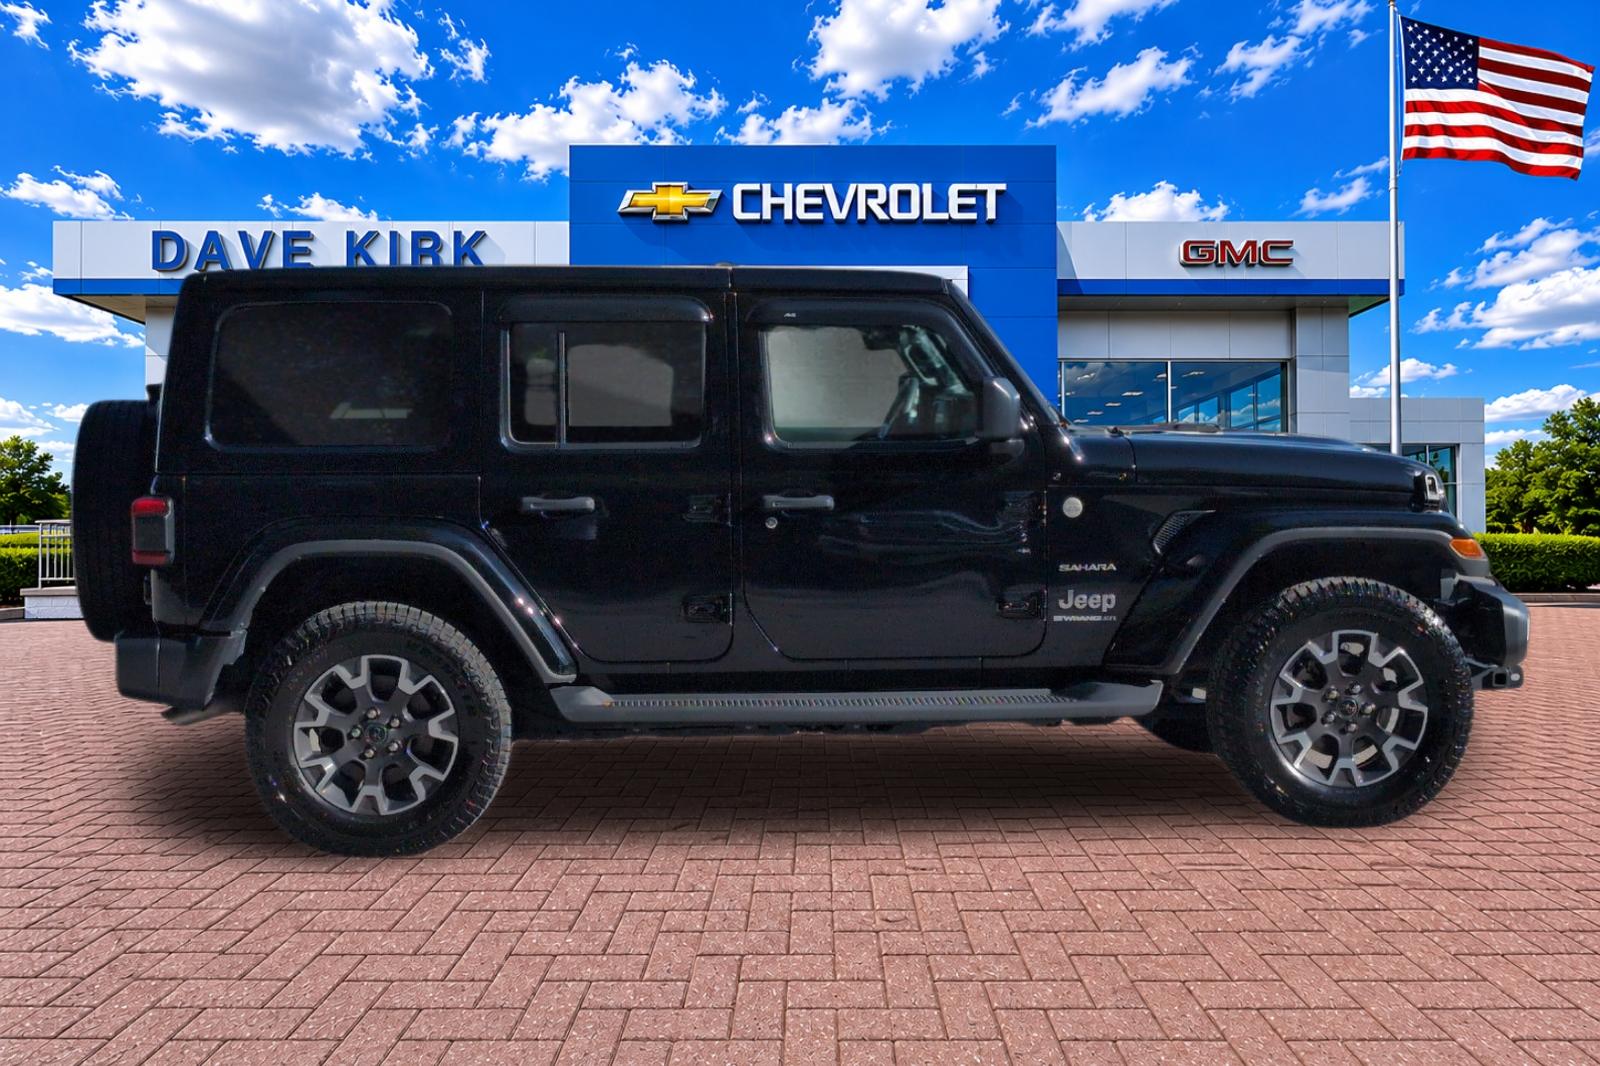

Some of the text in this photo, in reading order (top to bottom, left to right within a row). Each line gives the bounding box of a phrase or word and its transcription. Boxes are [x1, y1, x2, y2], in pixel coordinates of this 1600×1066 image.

[732, 183, 1007, 223] CHEVROLET
[152, 230, 487, 272] DAVE KIRK
[1179, 239, 1295, 267] GMC
[1058, 563, 1117, 572] SAHARA
[1058, 589, 1116, 613] Jeep
